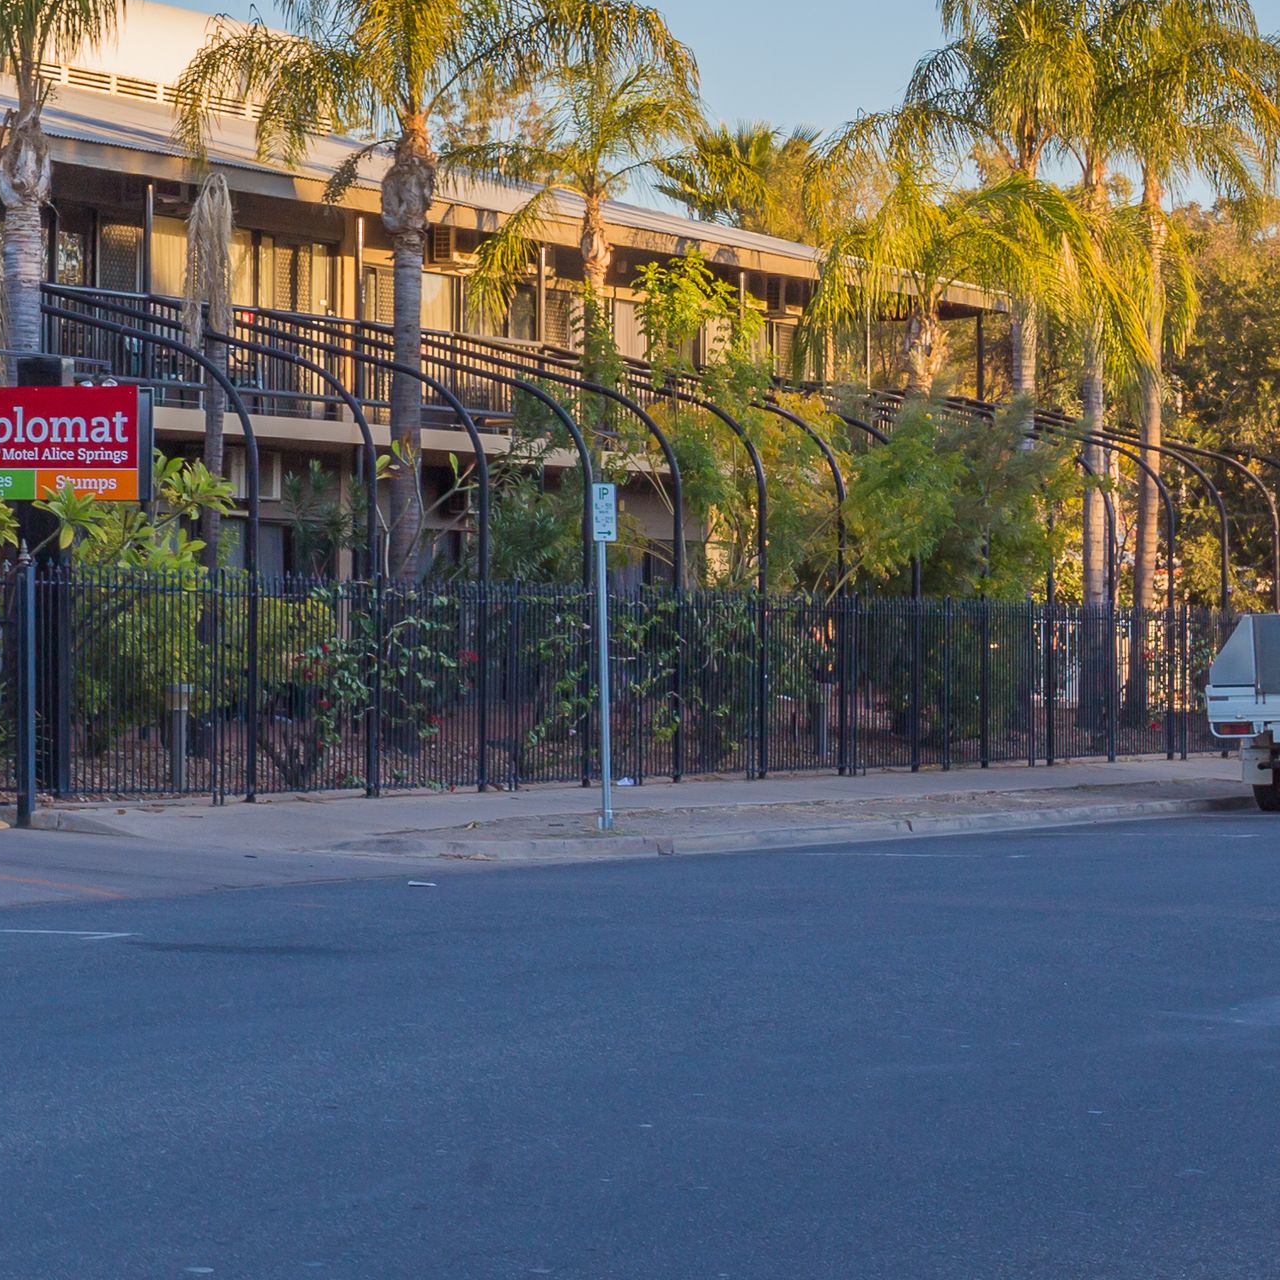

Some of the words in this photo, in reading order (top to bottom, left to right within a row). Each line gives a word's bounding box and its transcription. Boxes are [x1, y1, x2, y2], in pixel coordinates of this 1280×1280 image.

[2, 447, 39, 460] Motel
[42, 447, 74, 460] Alice
[77, 447, 129, 464] Springs
